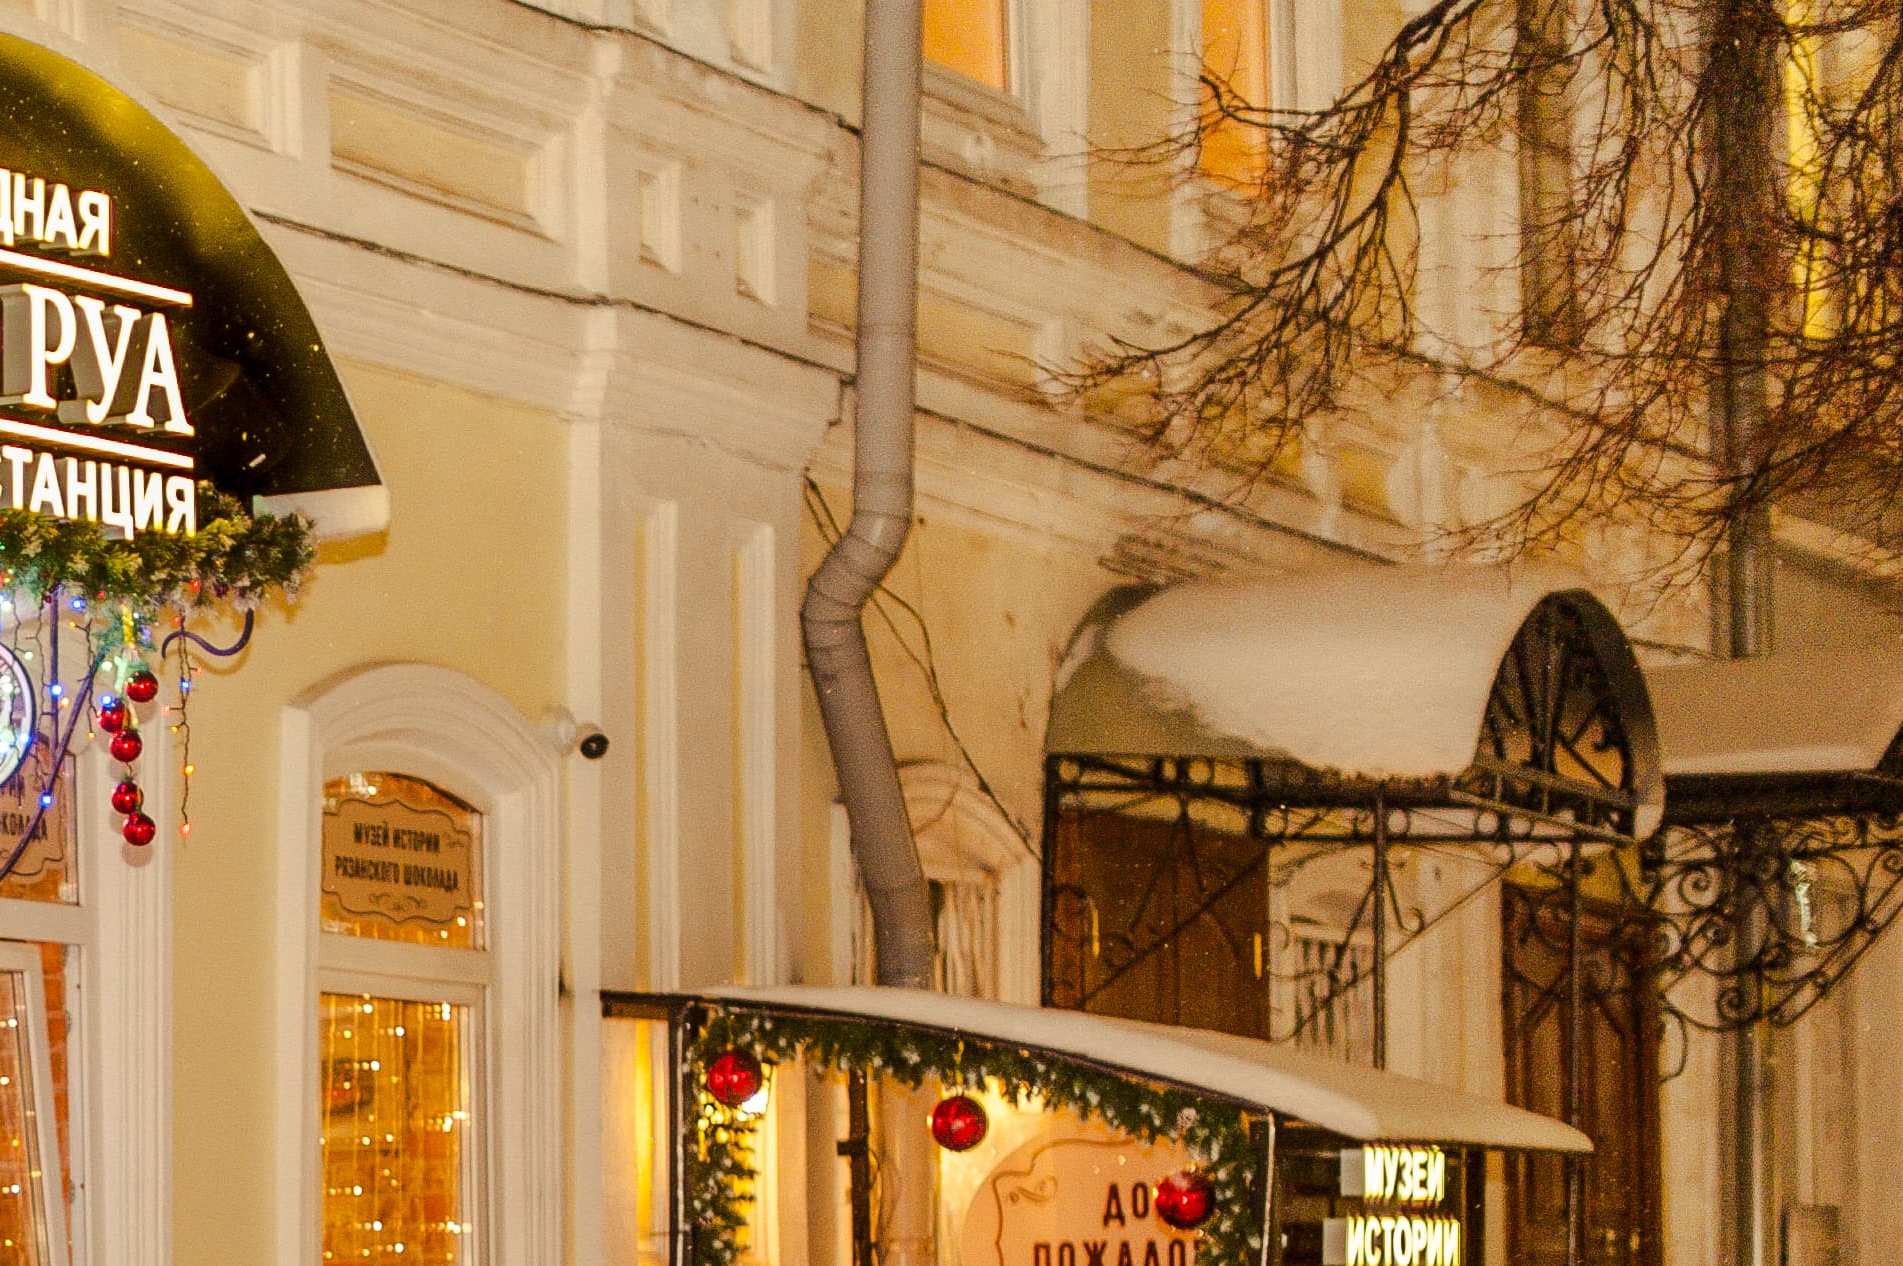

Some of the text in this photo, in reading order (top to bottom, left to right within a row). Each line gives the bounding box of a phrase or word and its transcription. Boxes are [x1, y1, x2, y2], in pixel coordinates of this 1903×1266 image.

[19, 282, 195, 437] РУА
[353, 821, 441, 855] МУЗЕЙ ИСТОРИИ
[335, 855, 459, 892] РЯЗАНСКОГО ШОКОЛАДА
[1363, 1145, 1445, 1202] МУЗЕЙ
